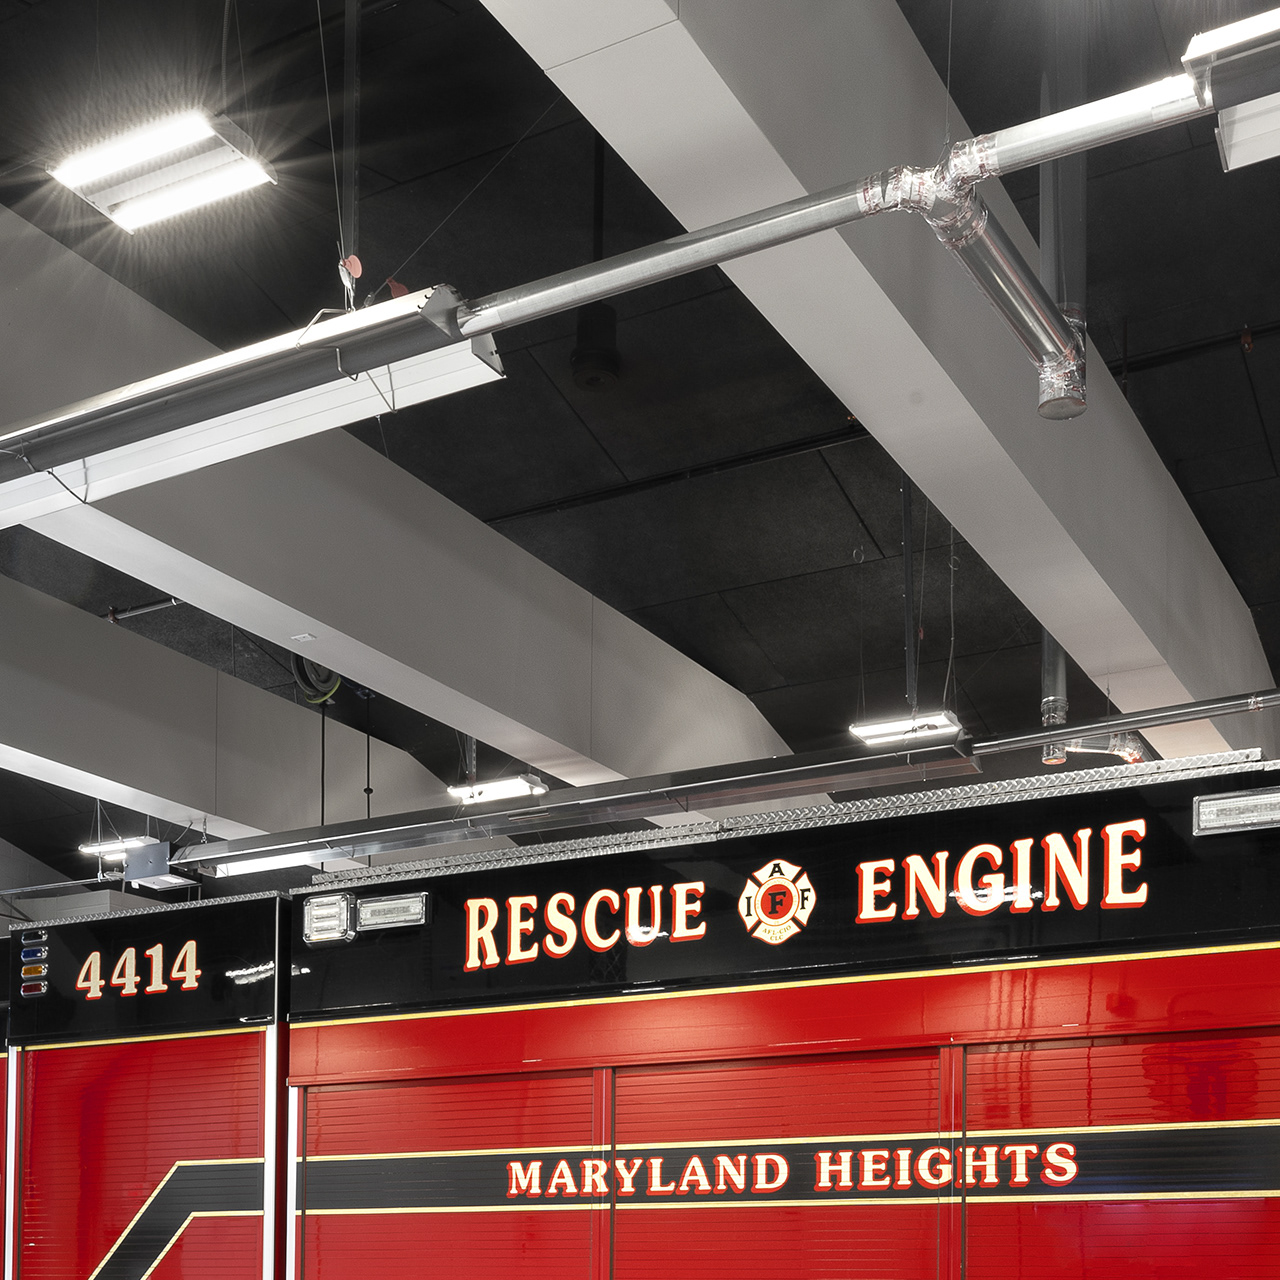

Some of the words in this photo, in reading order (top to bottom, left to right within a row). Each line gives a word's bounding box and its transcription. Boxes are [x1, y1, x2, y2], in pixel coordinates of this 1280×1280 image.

[768, 862, 786, 878] A
[463, 880, 707, 972] RESCUE
[855, 818, 1148, 926] ENGINE
[745, 895, 753, 917] I
[768, 890, 787, 915] F
[799, 887, 811, 910] F
[762, 924, 792, 936] AFL-CIO
[75, 940, 202, 1000] 4414
[506, 1153, 791, 1199] MARYLAND
[813, 1142, 1079, 1194] HEIGHTS
